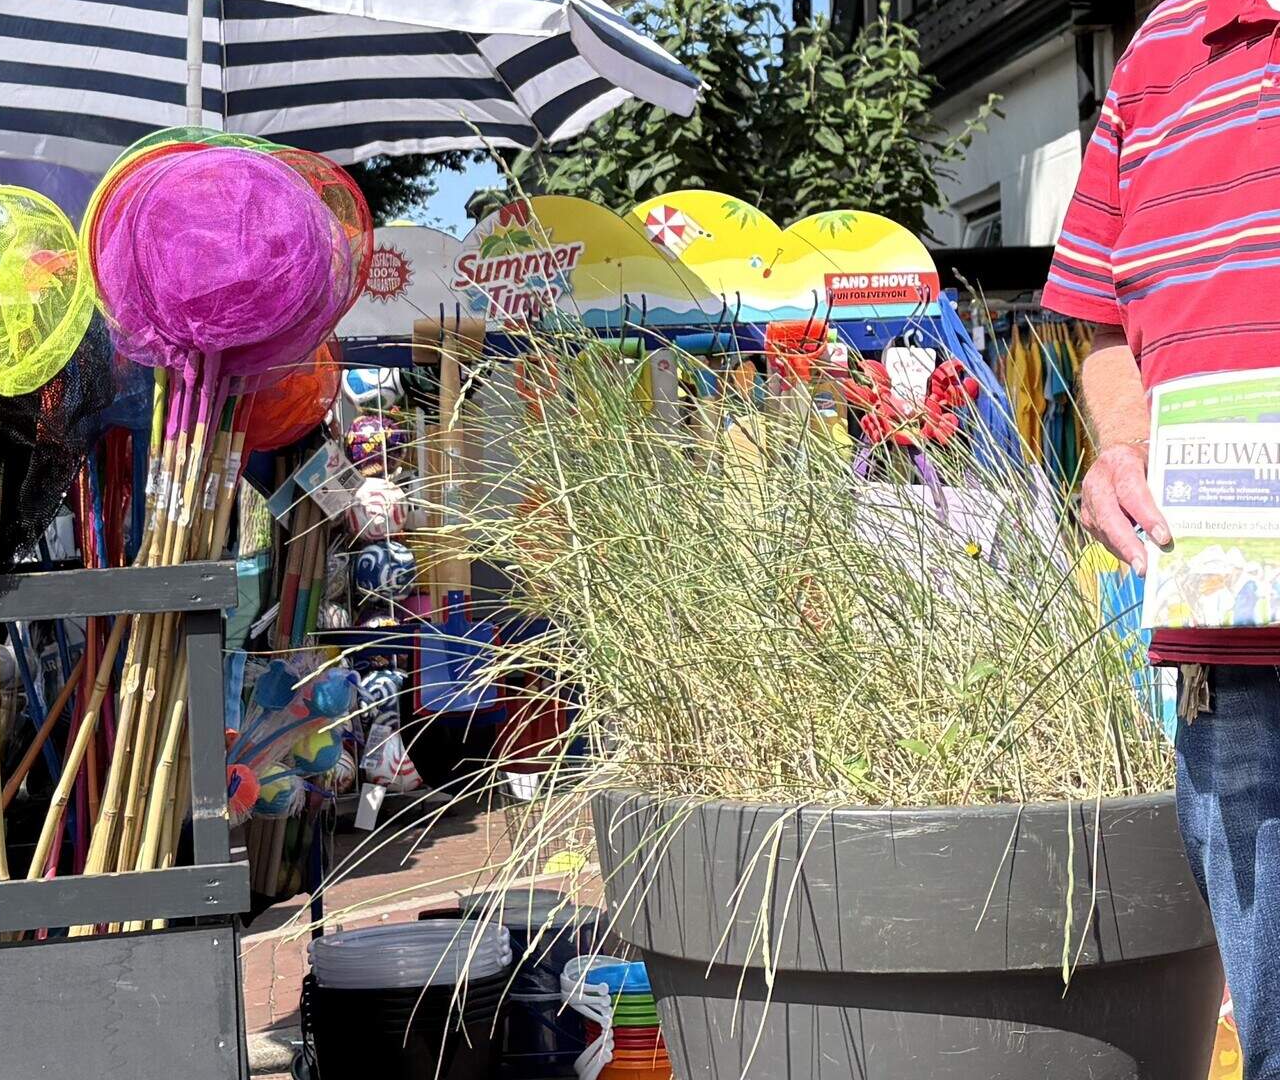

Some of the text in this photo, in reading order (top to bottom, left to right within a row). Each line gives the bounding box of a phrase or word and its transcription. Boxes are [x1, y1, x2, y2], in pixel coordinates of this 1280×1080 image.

[368, 267, 399, 279] 100%
[455, 244, 582, 289] Summer
[831, 273, 922, 289] SAND SHOVEL
[488, 284, 559, 319] Time
[849, 291, 866, 300] FOR
